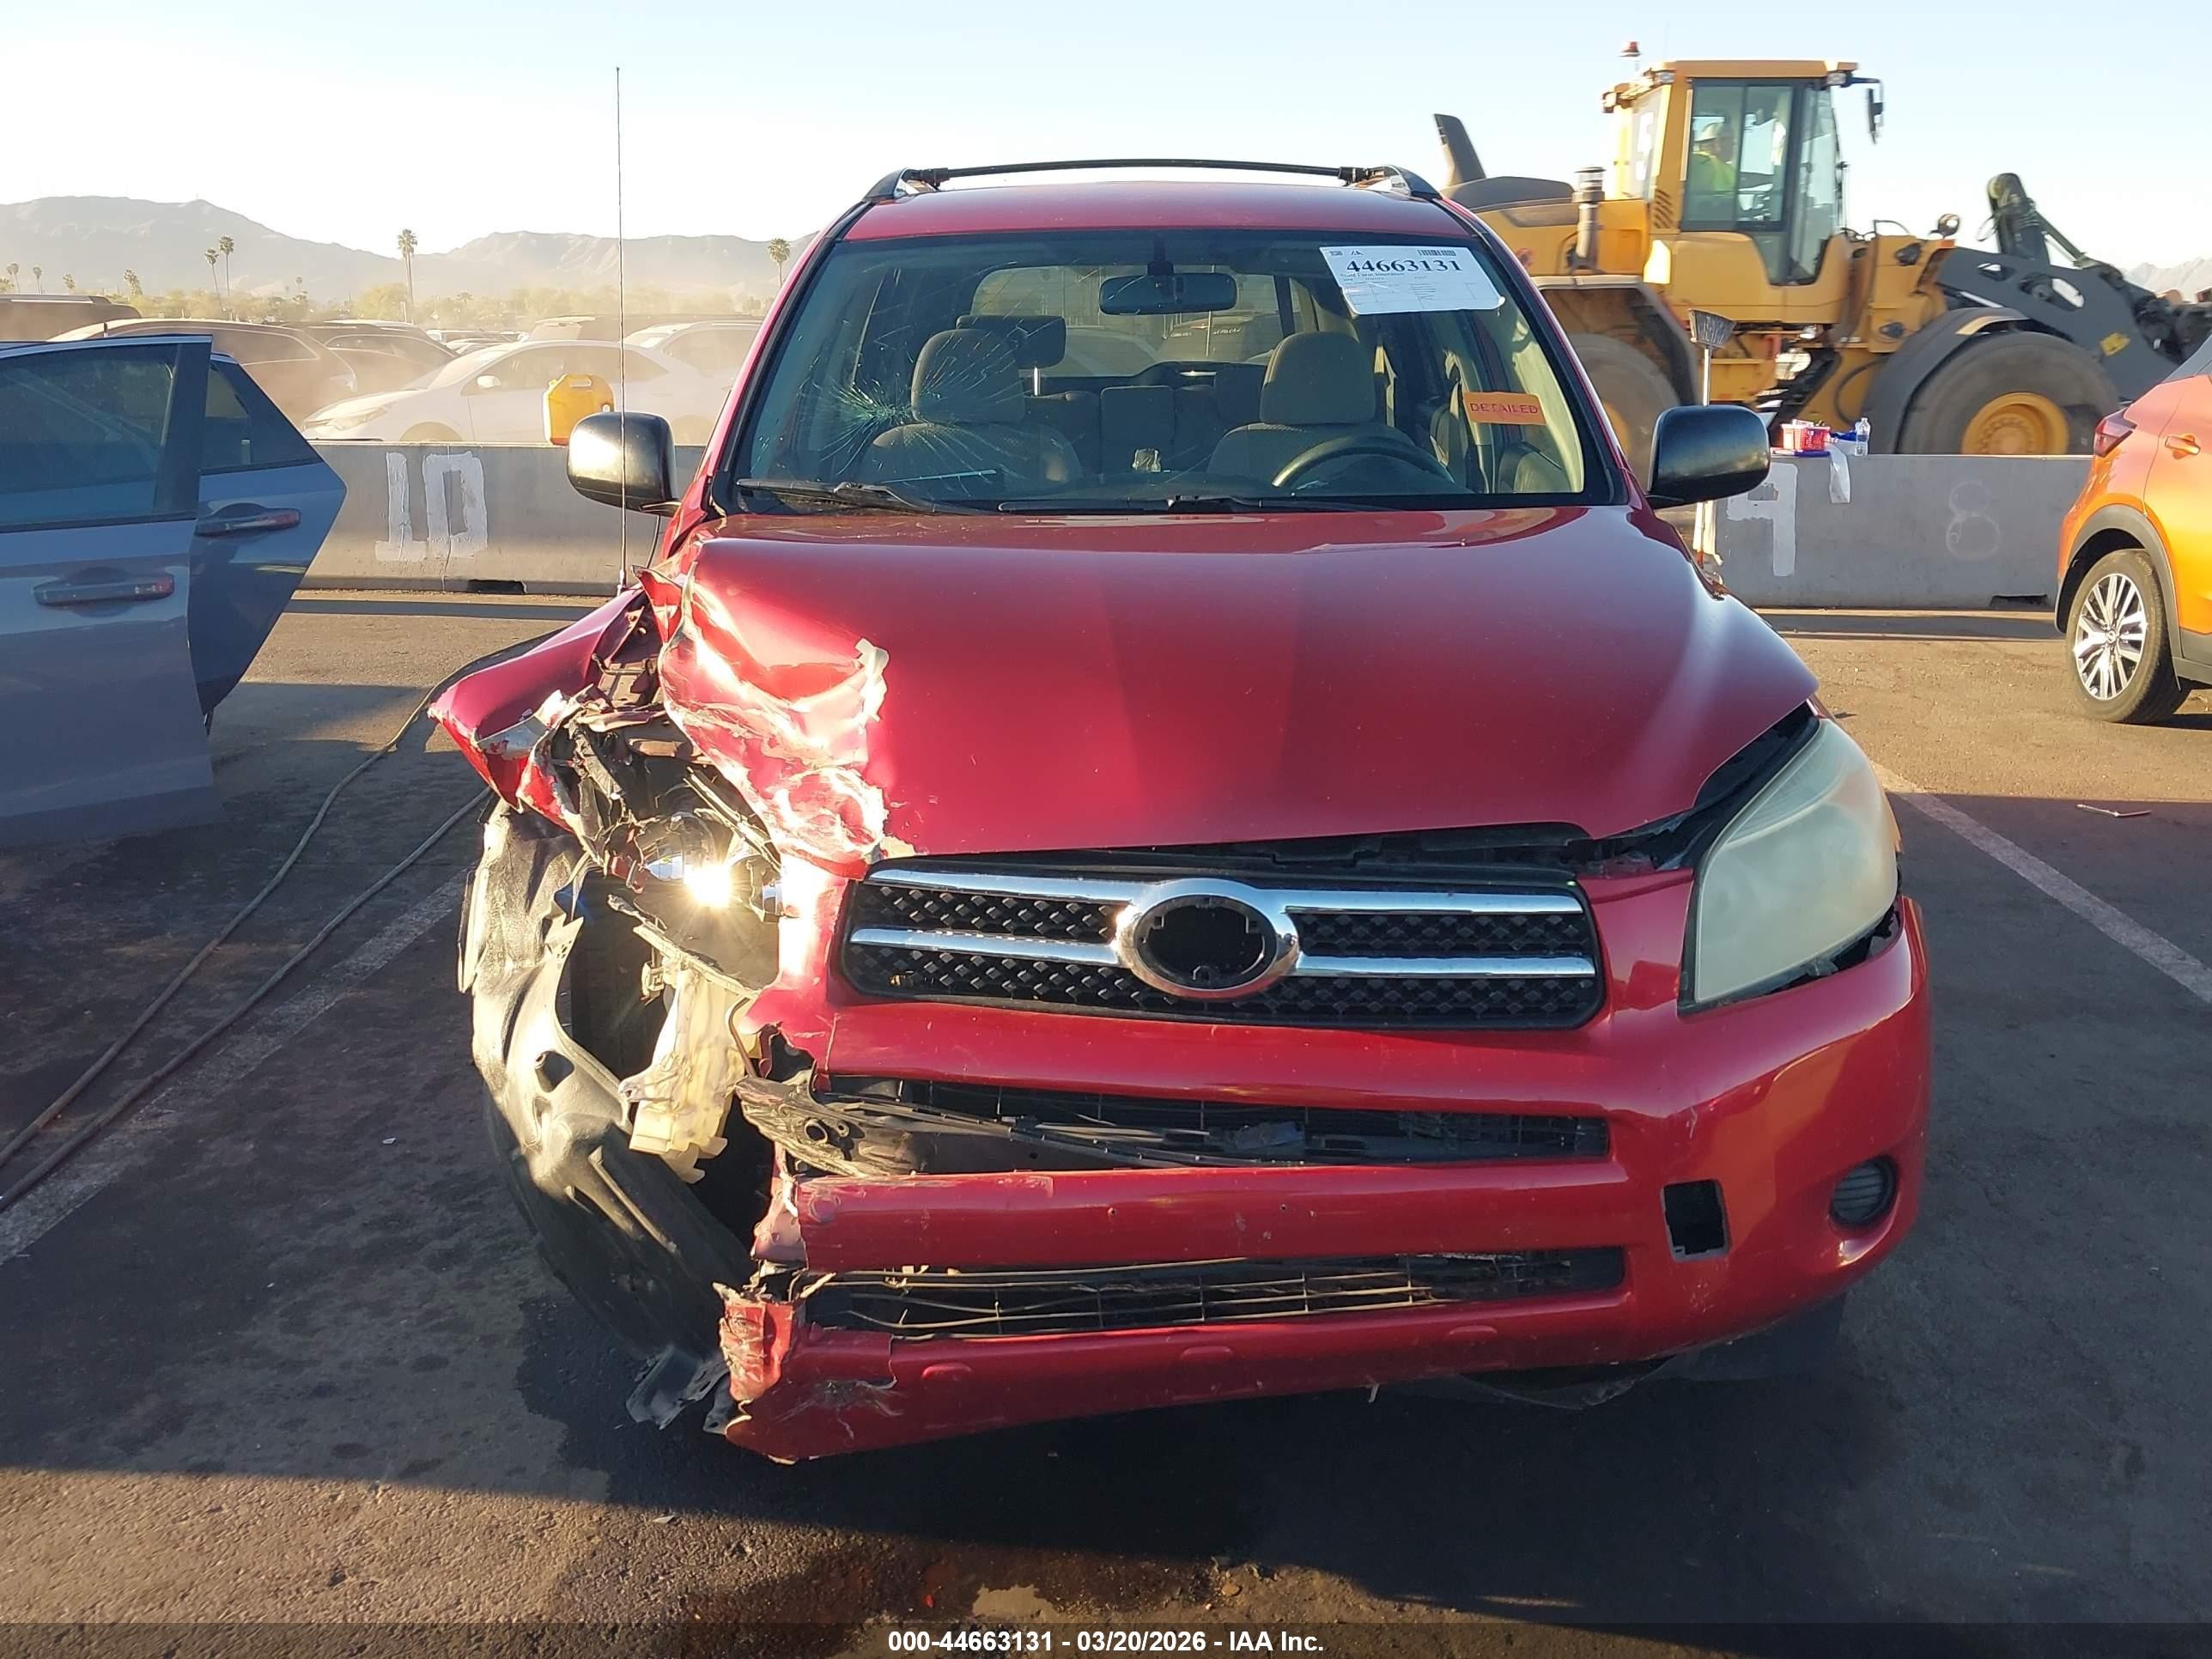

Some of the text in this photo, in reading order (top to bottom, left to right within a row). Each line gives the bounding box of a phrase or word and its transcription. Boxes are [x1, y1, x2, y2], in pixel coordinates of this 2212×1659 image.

[1346, 259, 1464, 272] 44663131
[1469, 403, 1539, 414] DETAILED
[375, 451, 489, 562] 10
